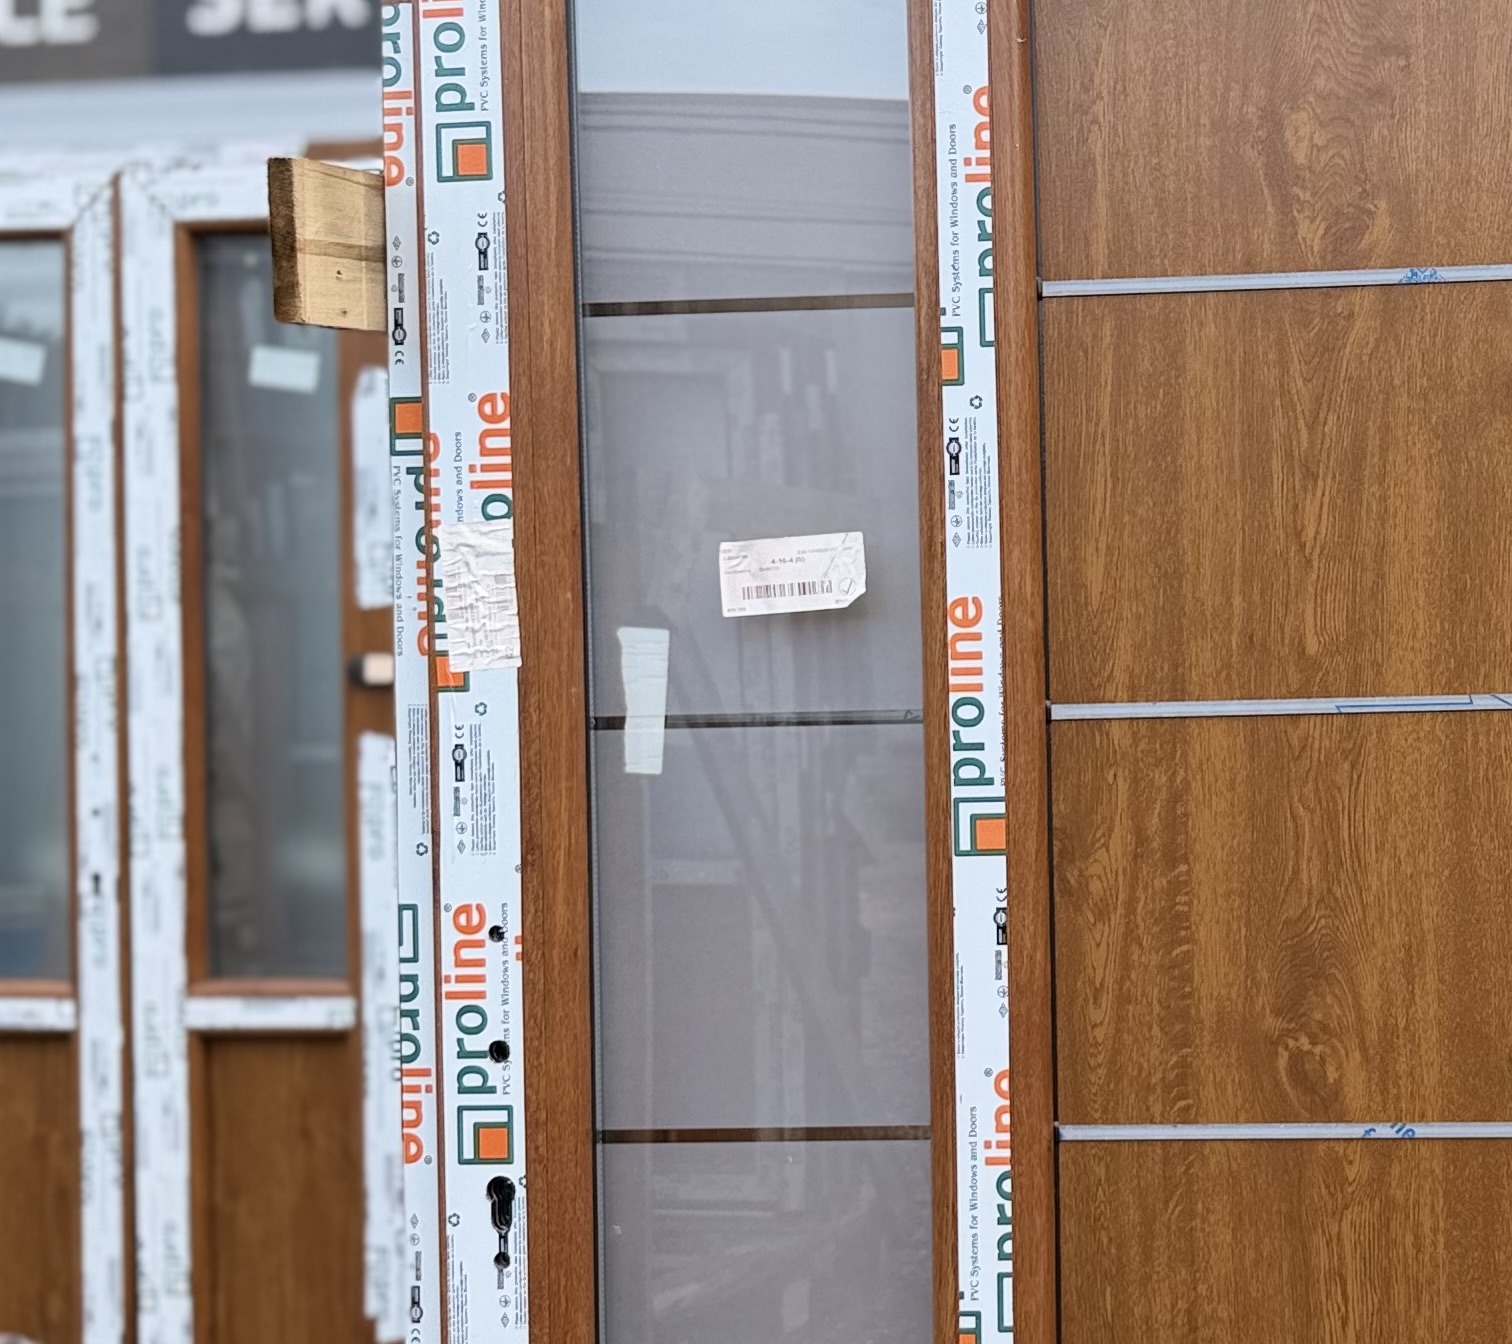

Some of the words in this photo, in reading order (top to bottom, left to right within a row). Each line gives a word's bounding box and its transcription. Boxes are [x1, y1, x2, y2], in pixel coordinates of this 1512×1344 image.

[477, 25, 487, 41] for
[479, 43, 491, 87] Systems
[479, 90, 489, 111] PVC
[947, 123, 957, 155] Doors
[947, 158, 958, 179] and
[948, 181, 959, 228] Windows
[949, 230, 959, 246] for
[950, 249, 963, 293] Systems
[951, 295, 961, 317] PVC
[470, 392, 513, 521] oline
[392, 465, 401, 485] PVC
[393, 489, 401, 532] Systems
[394, 535, 403, 550] for
[395, 553, 403, 600] Windows
[395, 602, 404, 622] and
[396, 625, 404, 657] Doors
[948, 596, 995, 787] proline
[444, 903, 497, 1095] proline
[968, 1105, 978, 1138] Doors
[968, 1140, 978, 1161] and
[968, 1164, 978, 1211] Windows
[969, 1213, 978, 1230] for
[969, 1232, 981, 1277] Systems
[969, 1279, 980, 1301] PVC
